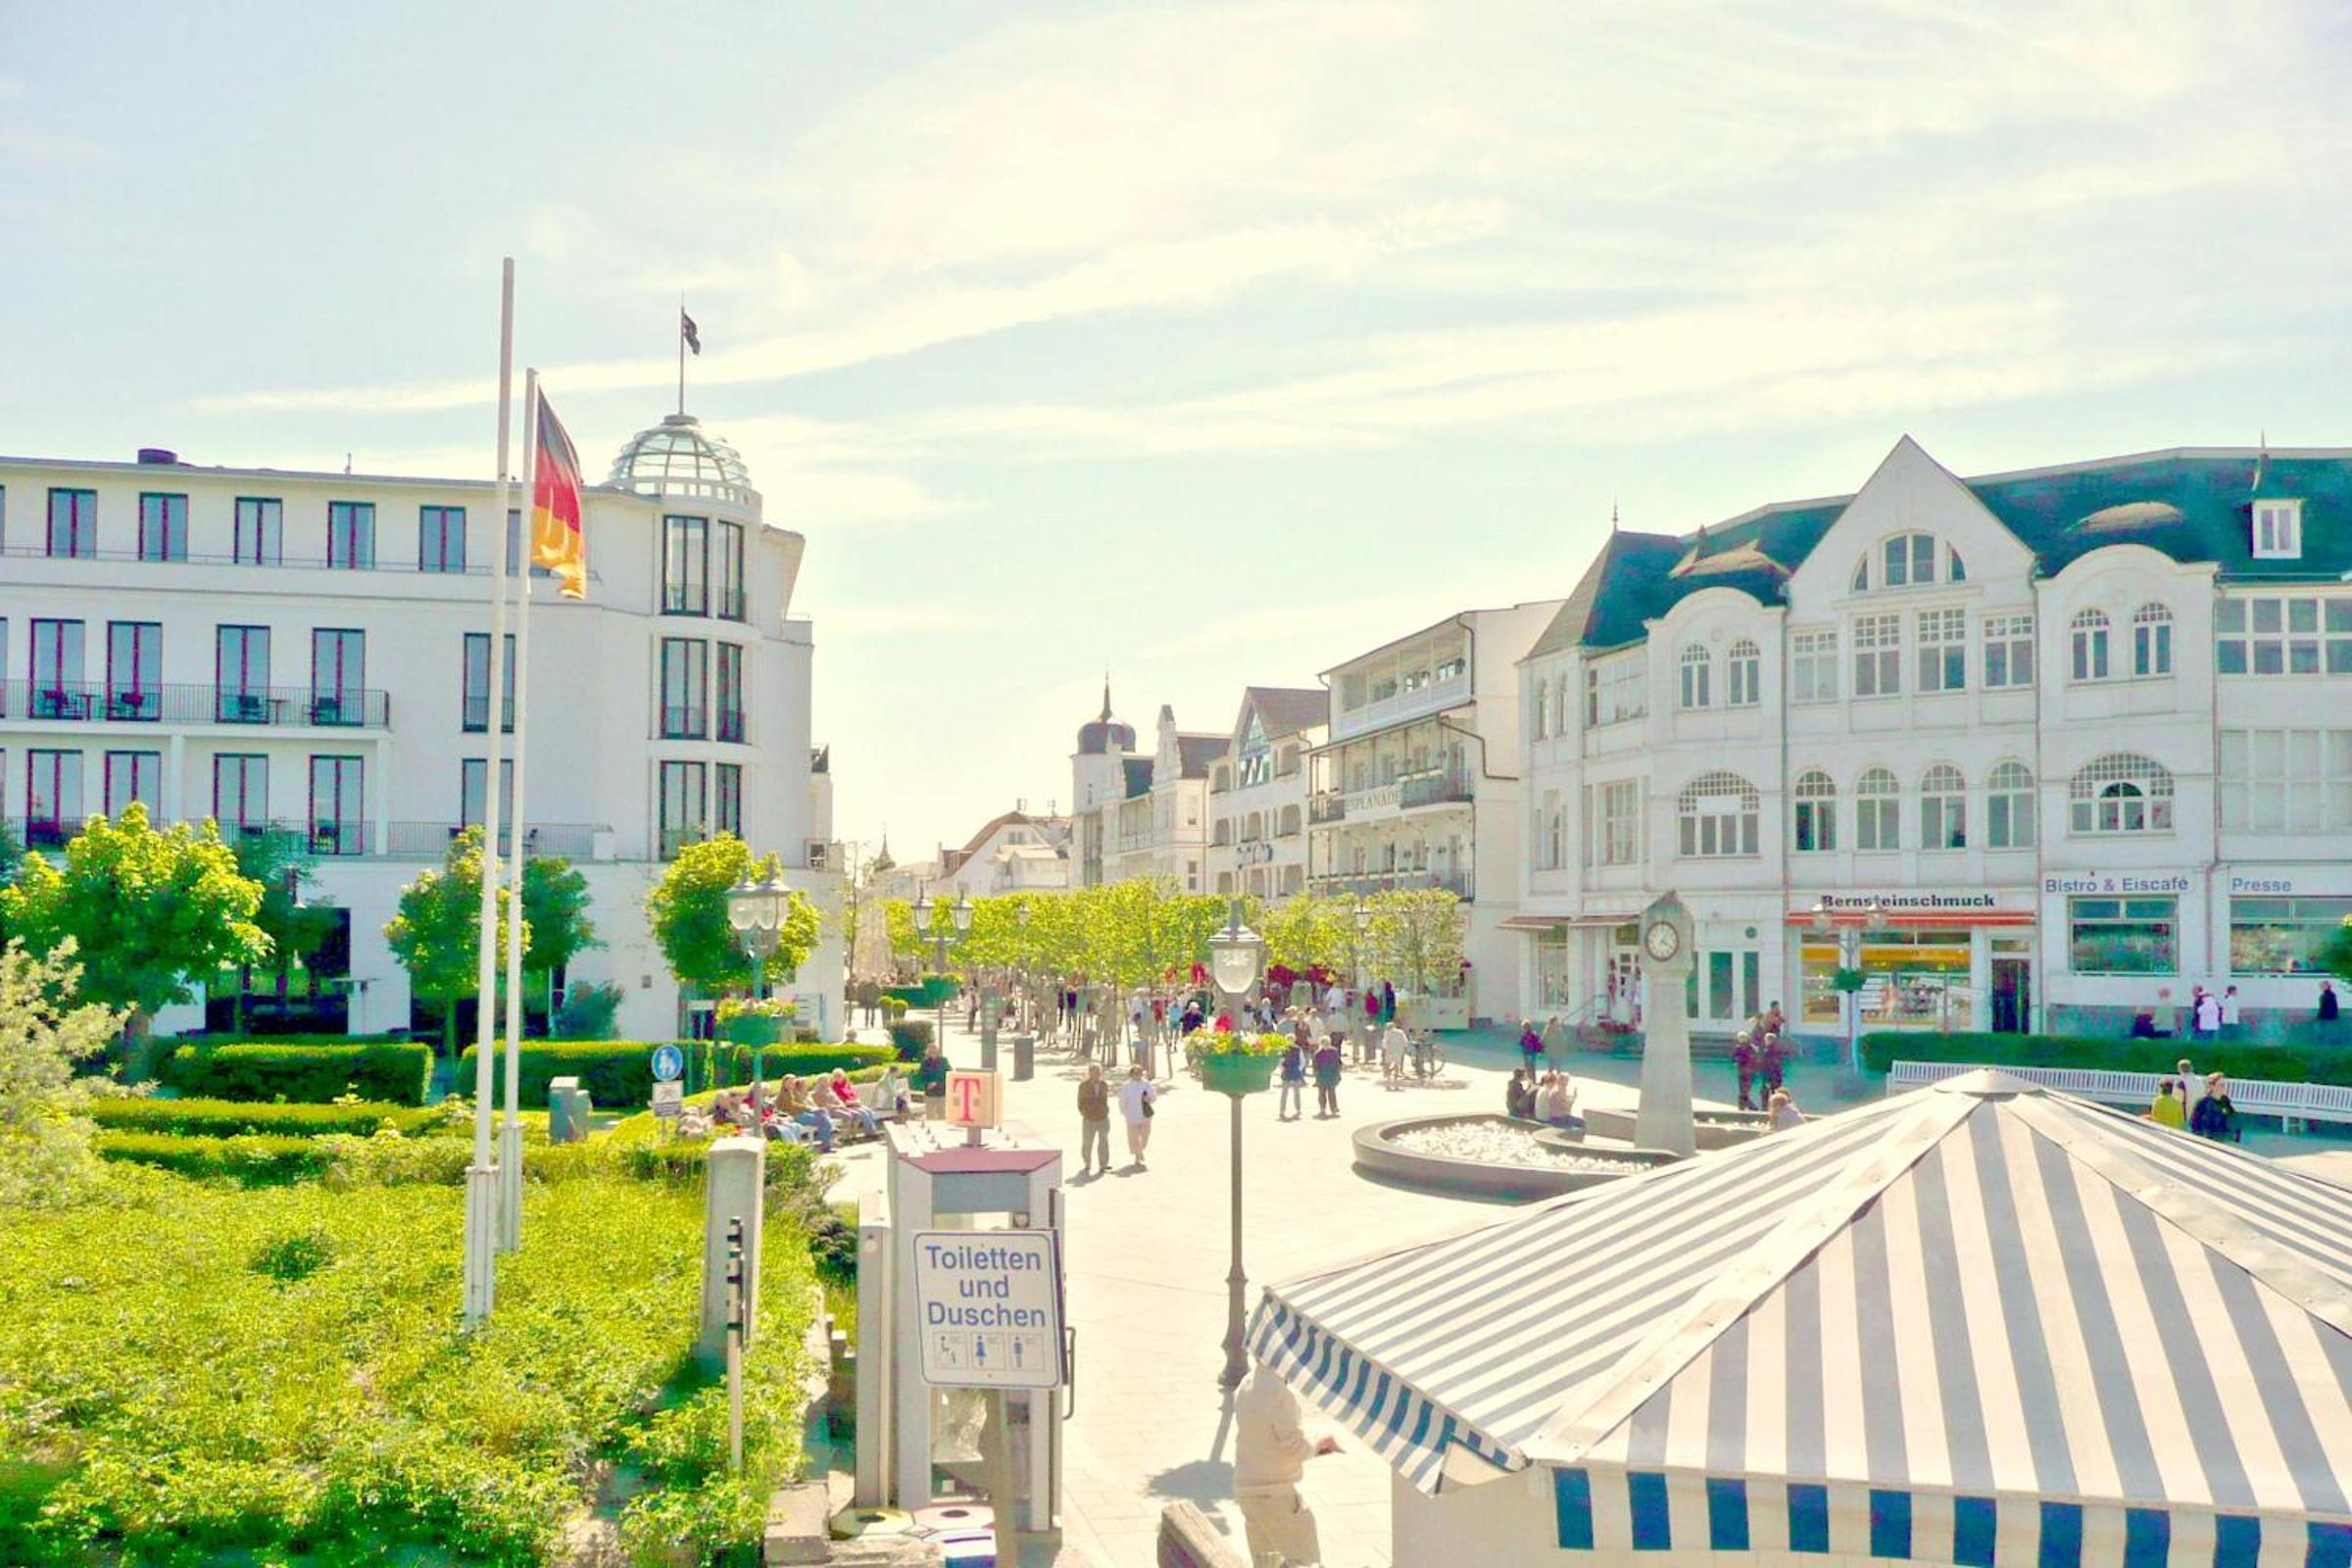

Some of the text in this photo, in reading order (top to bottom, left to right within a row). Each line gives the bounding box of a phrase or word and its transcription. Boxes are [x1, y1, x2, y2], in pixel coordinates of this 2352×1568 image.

[2045, 875, 2188, 893] Bistro & Eiscafé
[2231, 877, 2292, 892] Presse
[1821, 894, 1995, 907] Bernsteinschmuck
[952, 1077, 982, 1122] T
[925, 1245, 1042, 1271] Toiletten
[959, 1275, 1010, 1298] und
[927, 1301, 1047, 1328] Duschen
